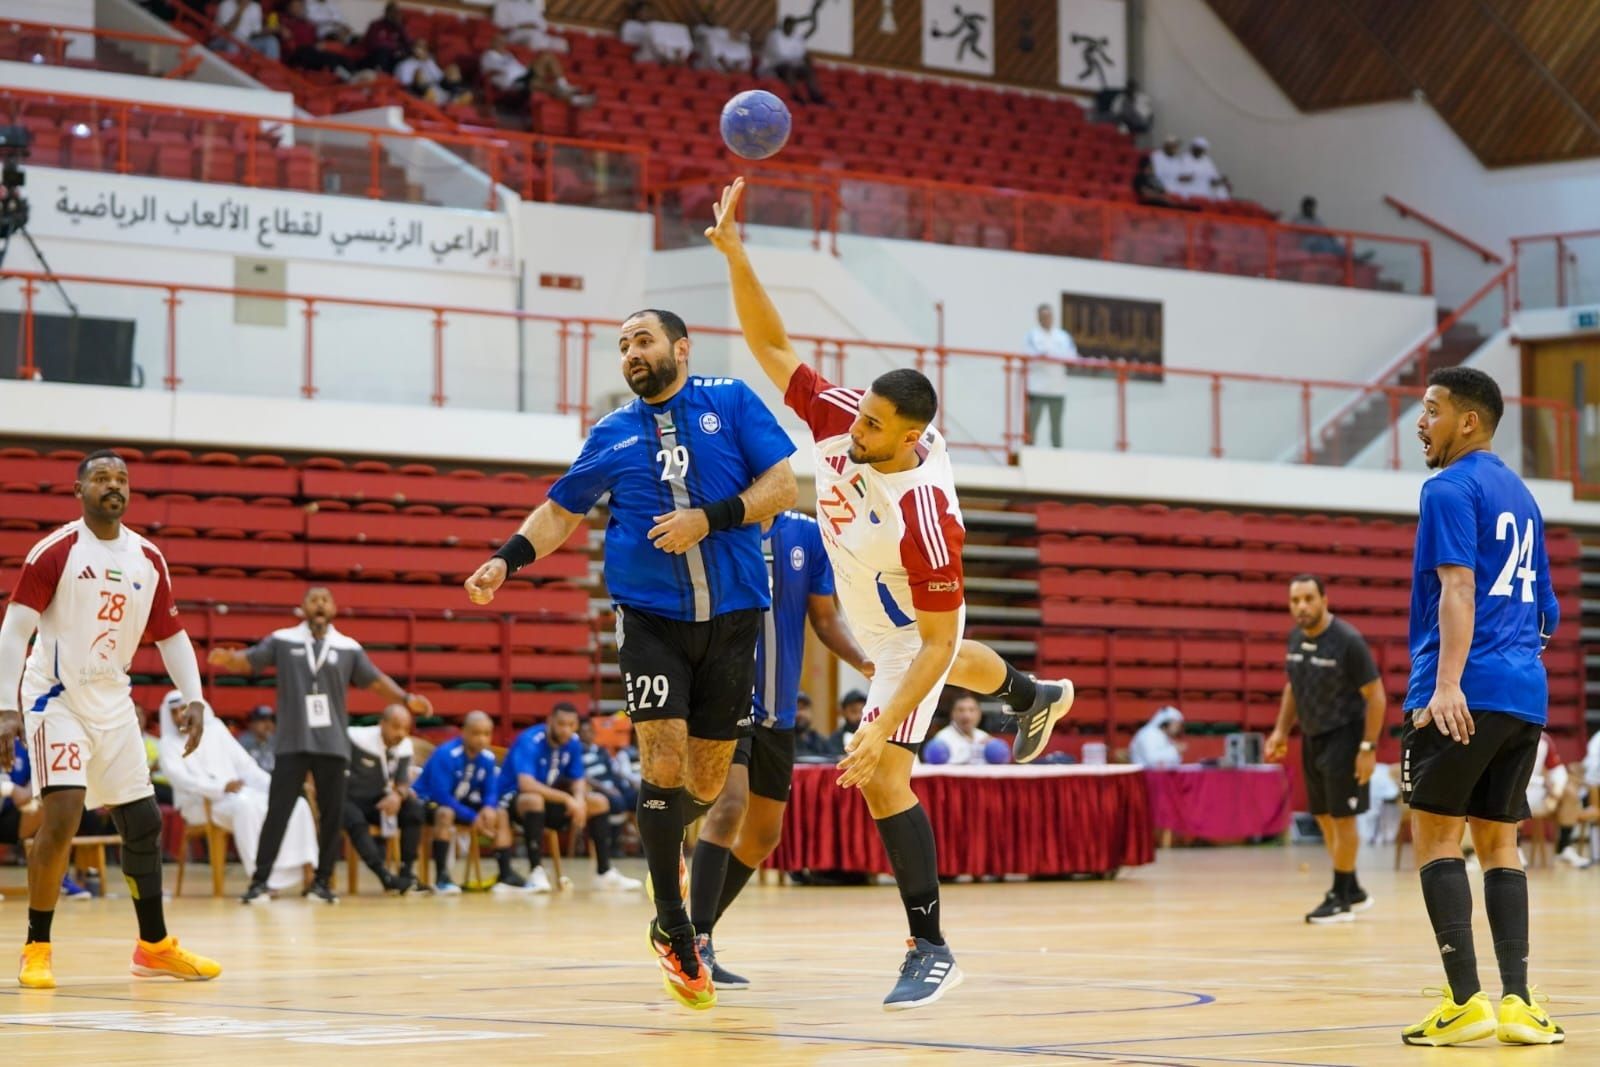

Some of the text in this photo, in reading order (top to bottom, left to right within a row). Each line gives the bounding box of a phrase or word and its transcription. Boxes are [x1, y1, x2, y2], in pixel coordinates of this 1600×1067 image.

[56, 185, 499, 263] الراعي الرئيسي لقطاع الألعاب الرياضية
[656, 445, 689, 481] 29
[819, 485, 856, 535] 22
[1488, 511, 1537, 603] 24
[97, 590, 126, 622] 28
[636, 674, 669, 709] 29
[50, 742, 81, 771] 28
